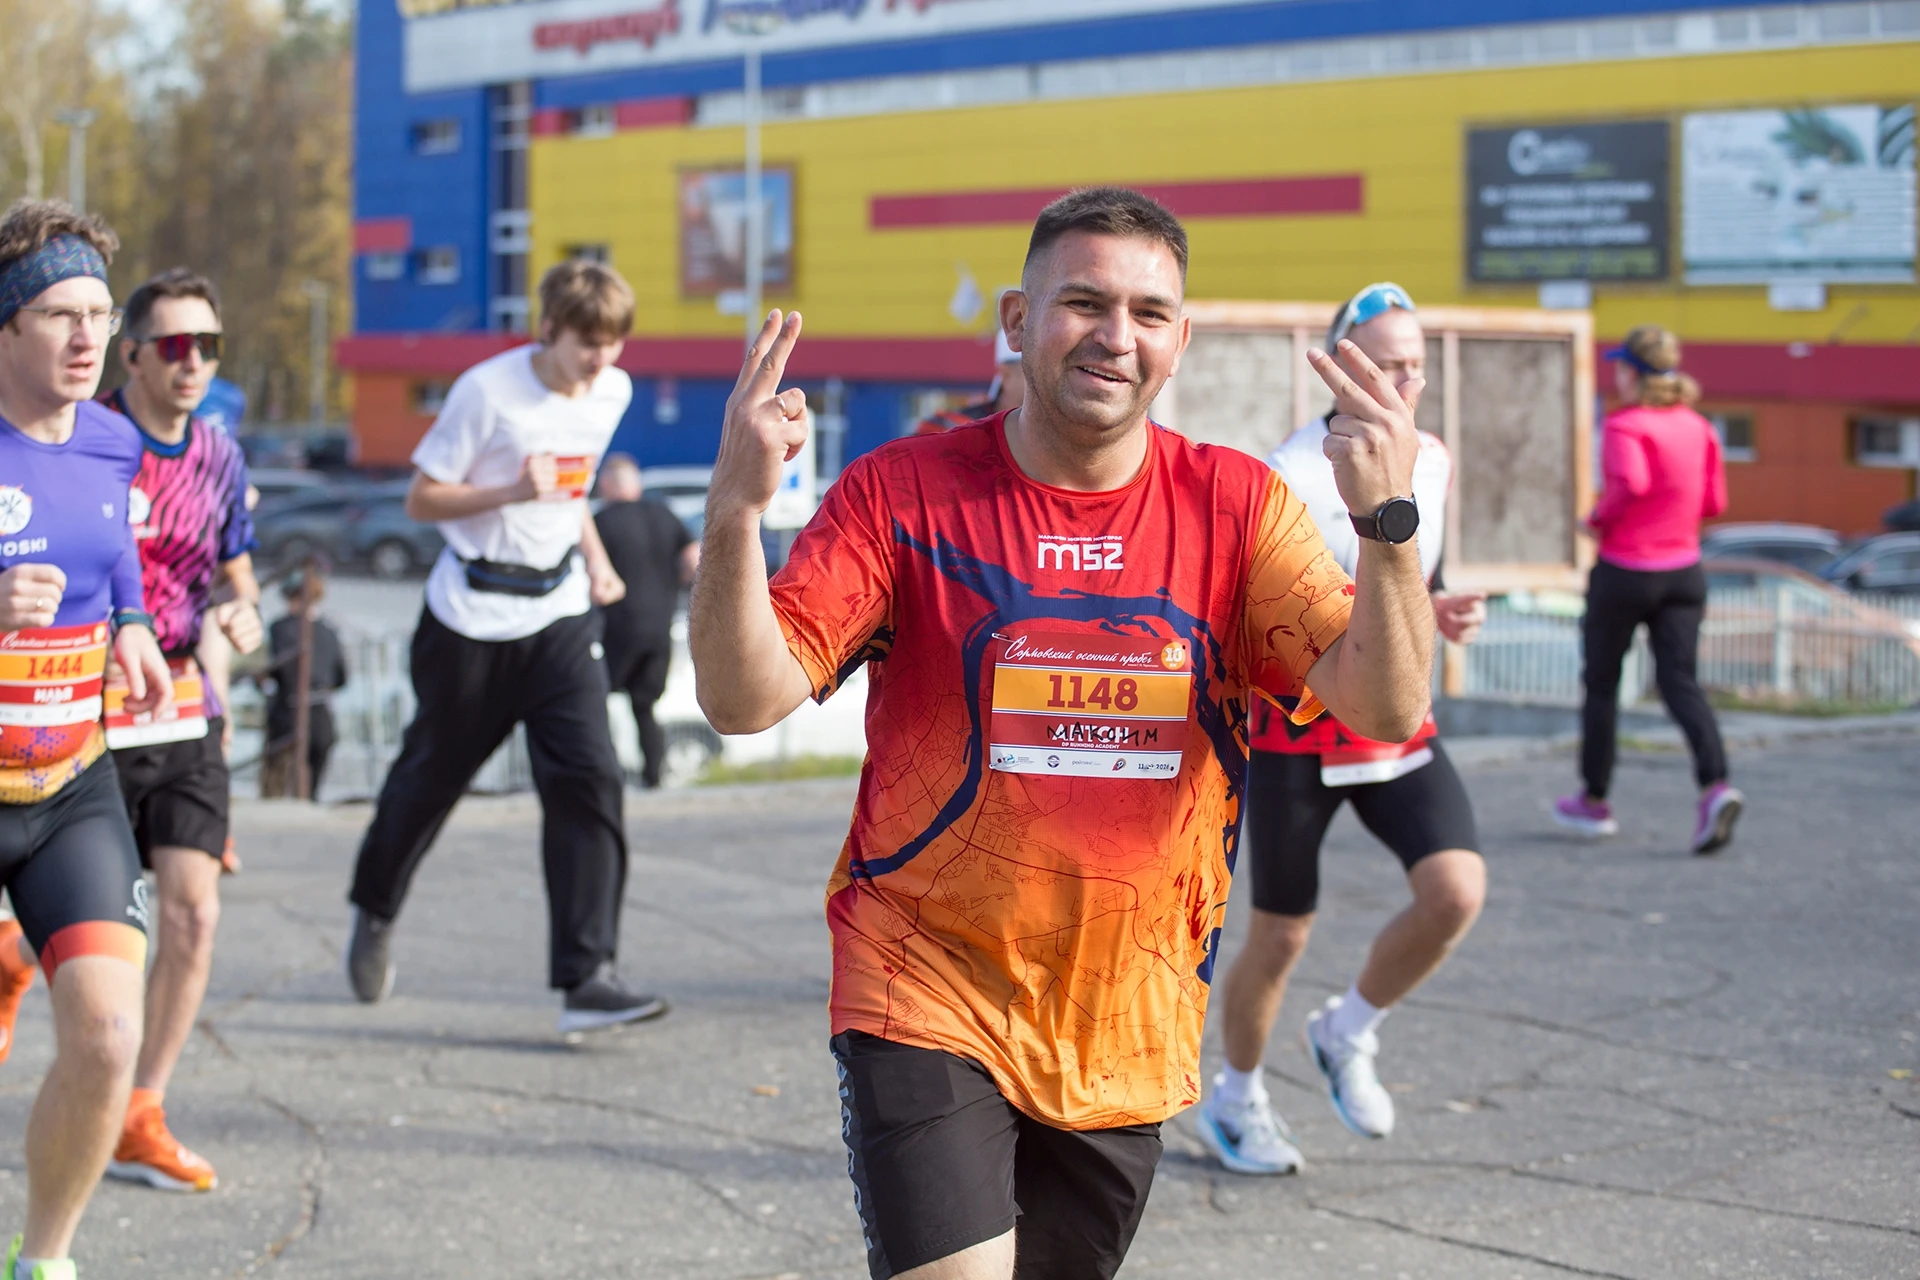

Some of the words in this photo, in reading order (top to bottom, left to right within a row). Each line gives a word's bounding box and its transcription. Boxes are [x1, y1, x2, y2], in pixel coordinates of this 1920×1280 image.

[0, 536, 48, 557] OSKI
[1004, 635, 1075, 661] Сормовский
[1076, 652, 1119, 662] осенний
[1119, 652, 1152, 667] пробег
[1164, 647, 1183, 663] 10
[26, 654, 83, 679] 1444
[1047, 674, 1139, 712] 1148
